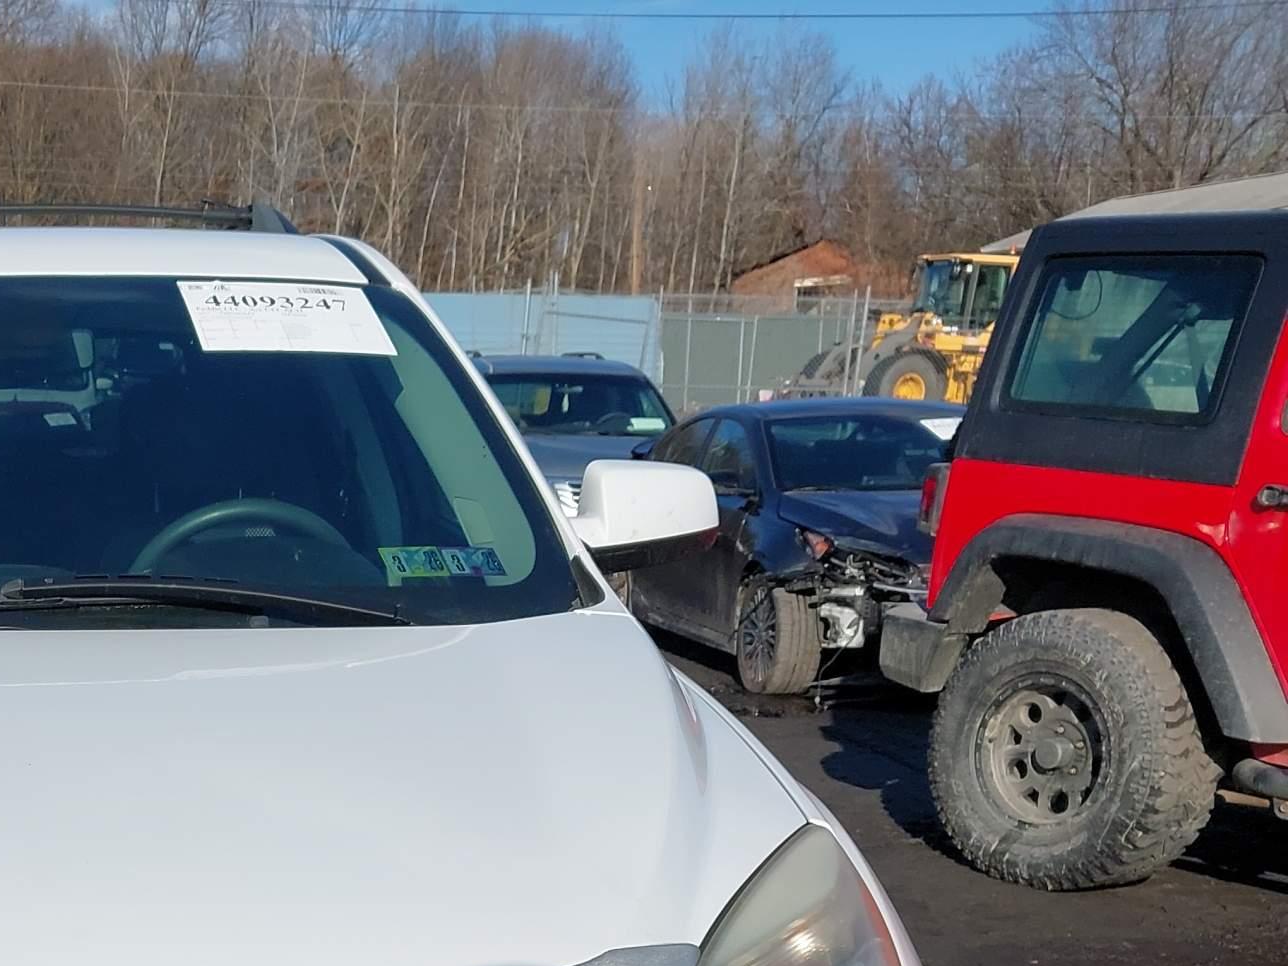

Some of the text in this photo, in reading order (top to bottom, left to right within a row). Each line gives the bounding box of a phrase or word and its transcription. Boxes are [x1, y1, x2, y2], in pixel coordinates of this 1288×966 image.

[205, 294, 346, 312] 44093247
[392, 555, 407, 573] 3
[450, 554, 466, 572] 3
